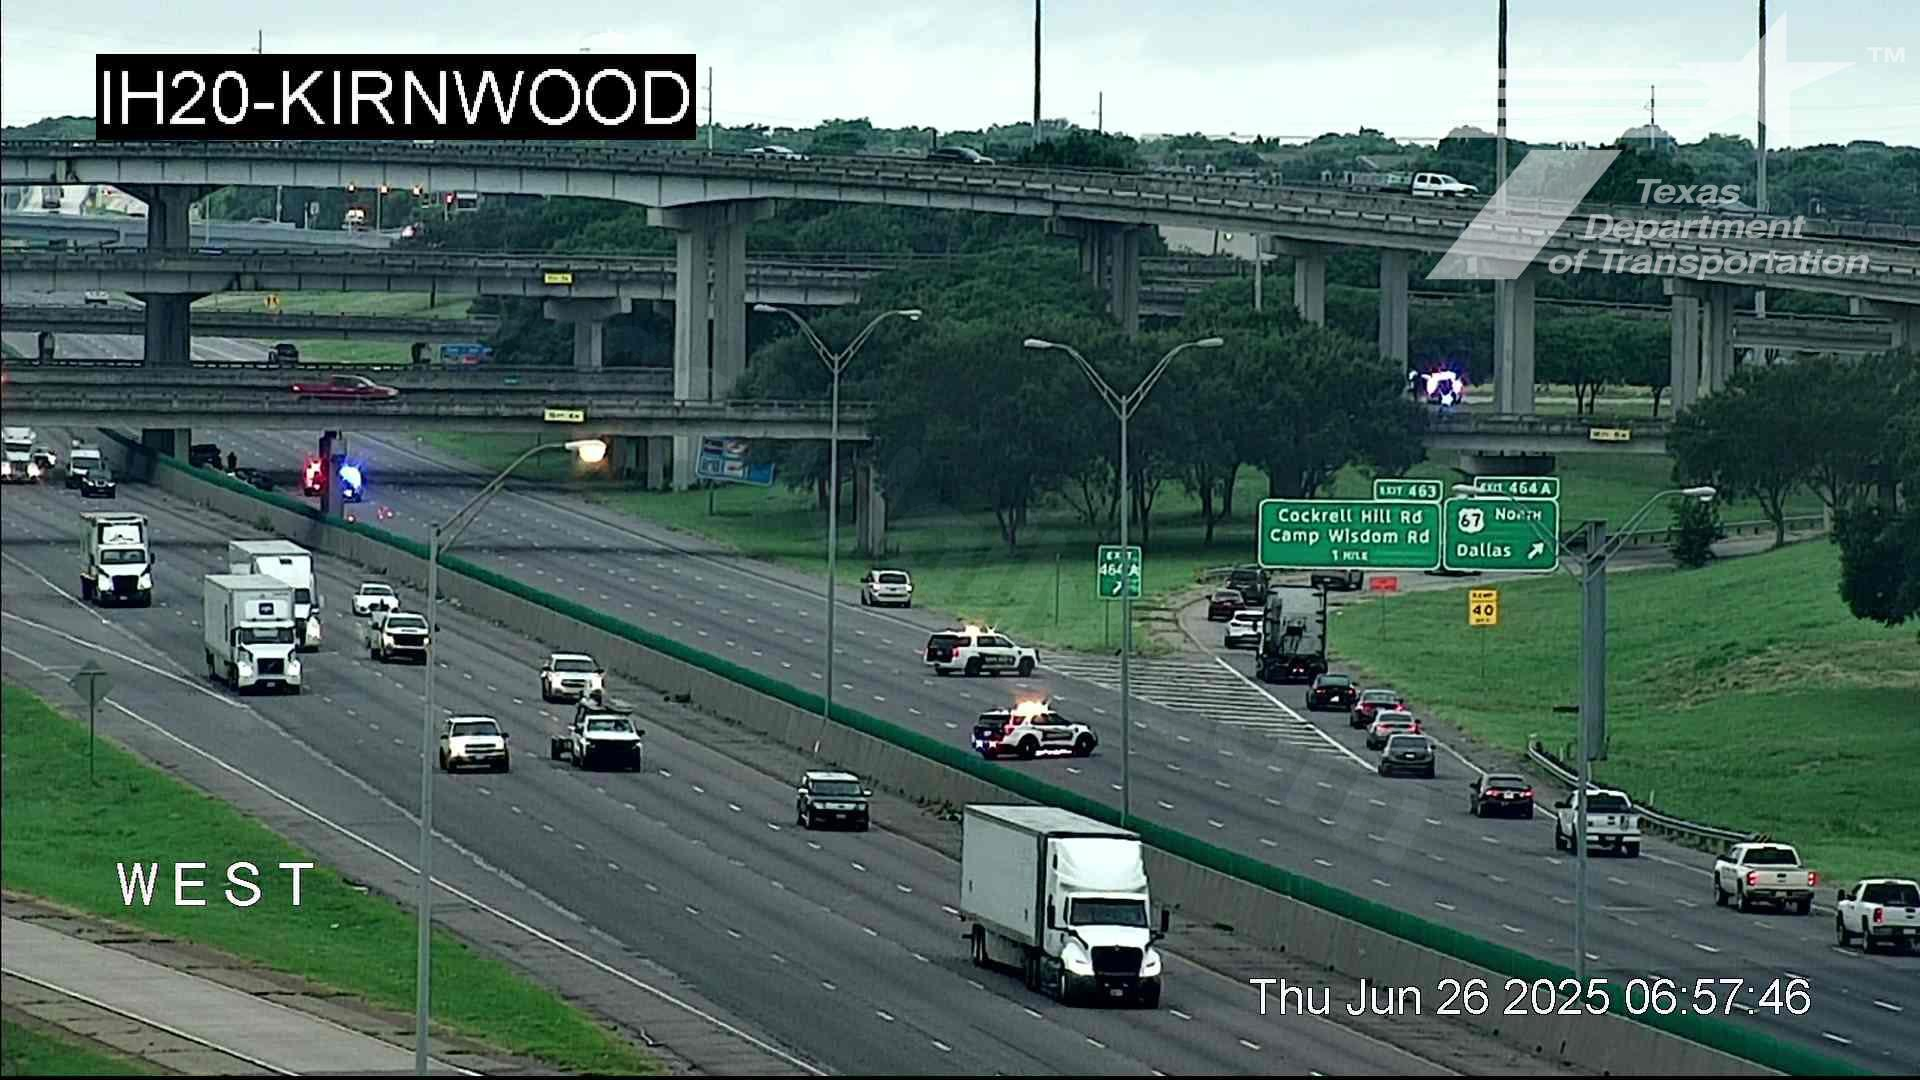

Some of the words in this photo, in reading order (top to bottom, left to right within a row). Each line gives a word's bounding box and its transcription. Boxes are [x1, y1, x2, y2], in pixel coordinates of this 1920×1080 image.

[1409, 484, 1437, 498] 463
[1278, 508, 1352, 523] Cockrell
[1361, 508, 1391, 524] Hill
[1400, 509, 1423, 524] Rd
[1461, 513, 1481, 527] 67
[1270, 528, 1319, 545] Camp
[1328, 527, 1398, 543] Wisdom
[1407, 528, 1429, 544] Rd
[1332, 550, 1338, 561] 1
[1457, 542, 1511, 557] Dallas
[1473, 604, 1494, 616] 40
